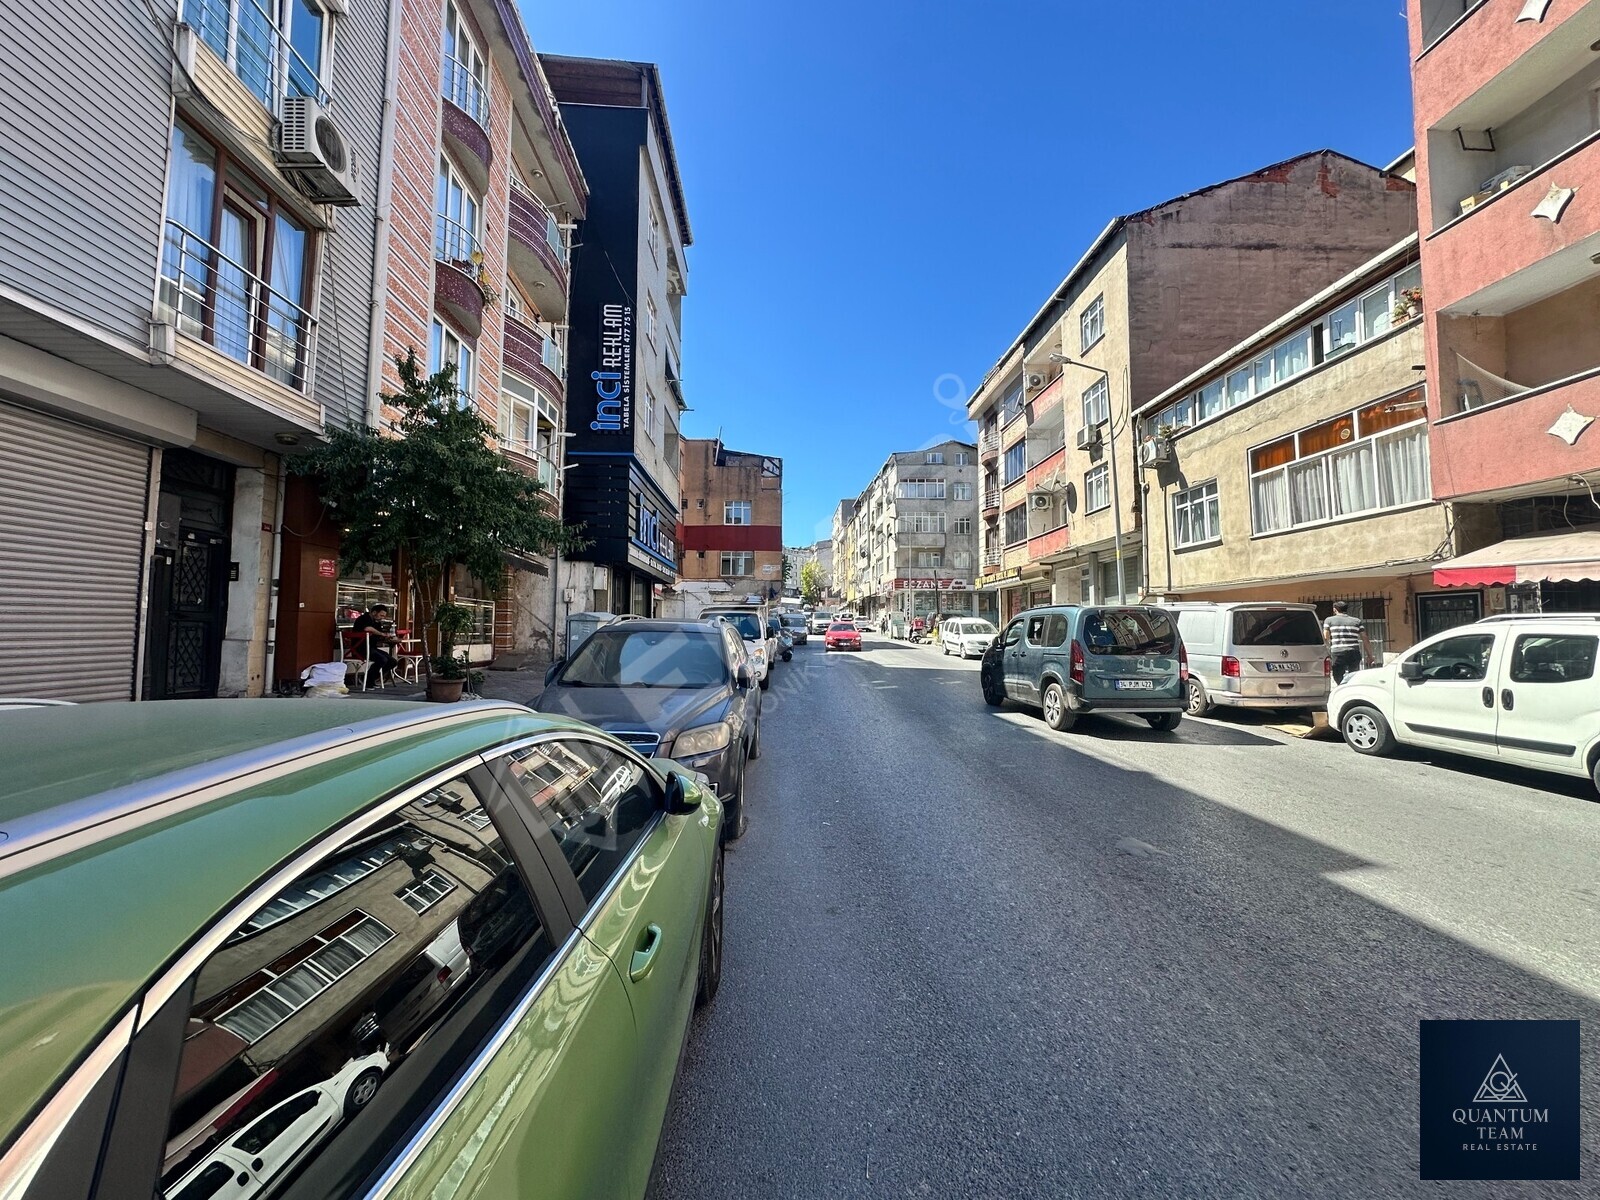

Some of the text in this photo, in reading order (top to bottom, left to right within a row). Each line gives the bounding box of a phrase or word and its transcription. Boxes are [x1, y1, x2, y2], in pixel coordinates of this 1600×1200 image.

[624, 306, 631, 315] 15
[624, 316, 631, 328] 75
[590, 304, 622, 431] inci REKLAM
[903, 580, 943, 589] ECZANE
